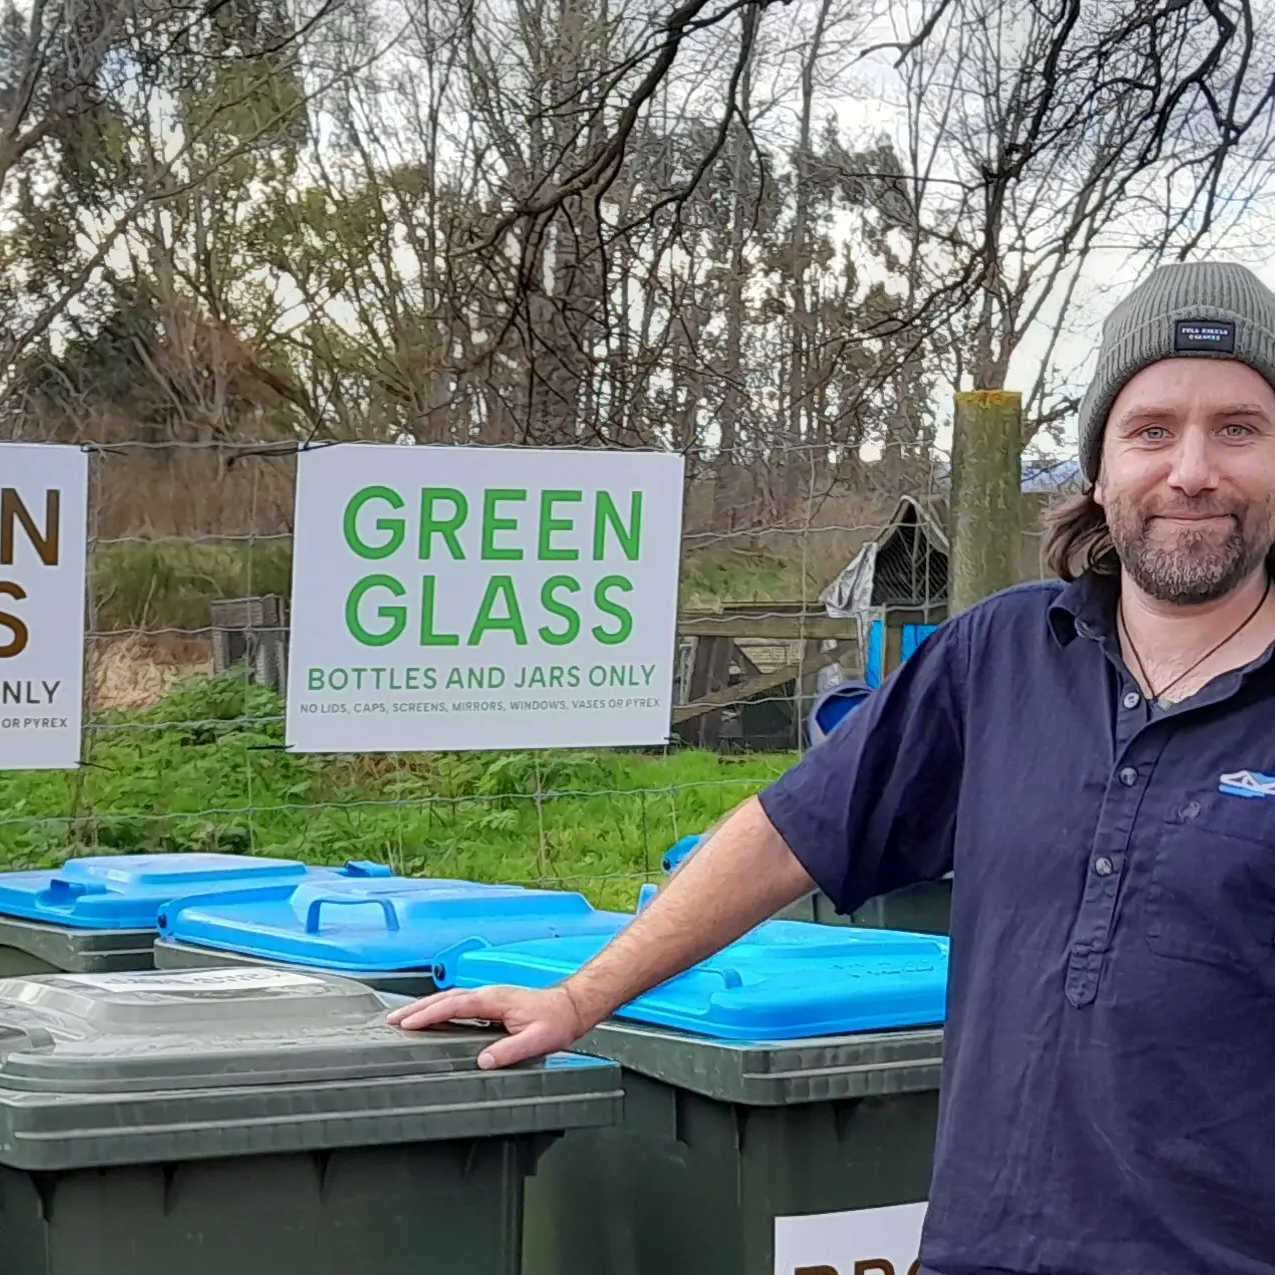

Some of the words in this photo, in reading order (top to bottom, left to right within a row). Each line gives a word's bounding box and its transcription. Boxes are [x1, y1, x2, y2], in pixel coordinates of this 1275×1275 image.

[342, 485, 643, 561] GREEN
[345, 573, 635, 647] GLASS
[308, 667, 437, 691] BOTTLES
[445, 666, 506, 689] AND
[513, 665, 581, 688] JARS
[588, 664, 656, 687] ONLY
[2, 718, 20, 729] OR
[23, 717, 69, 729] PYREX
